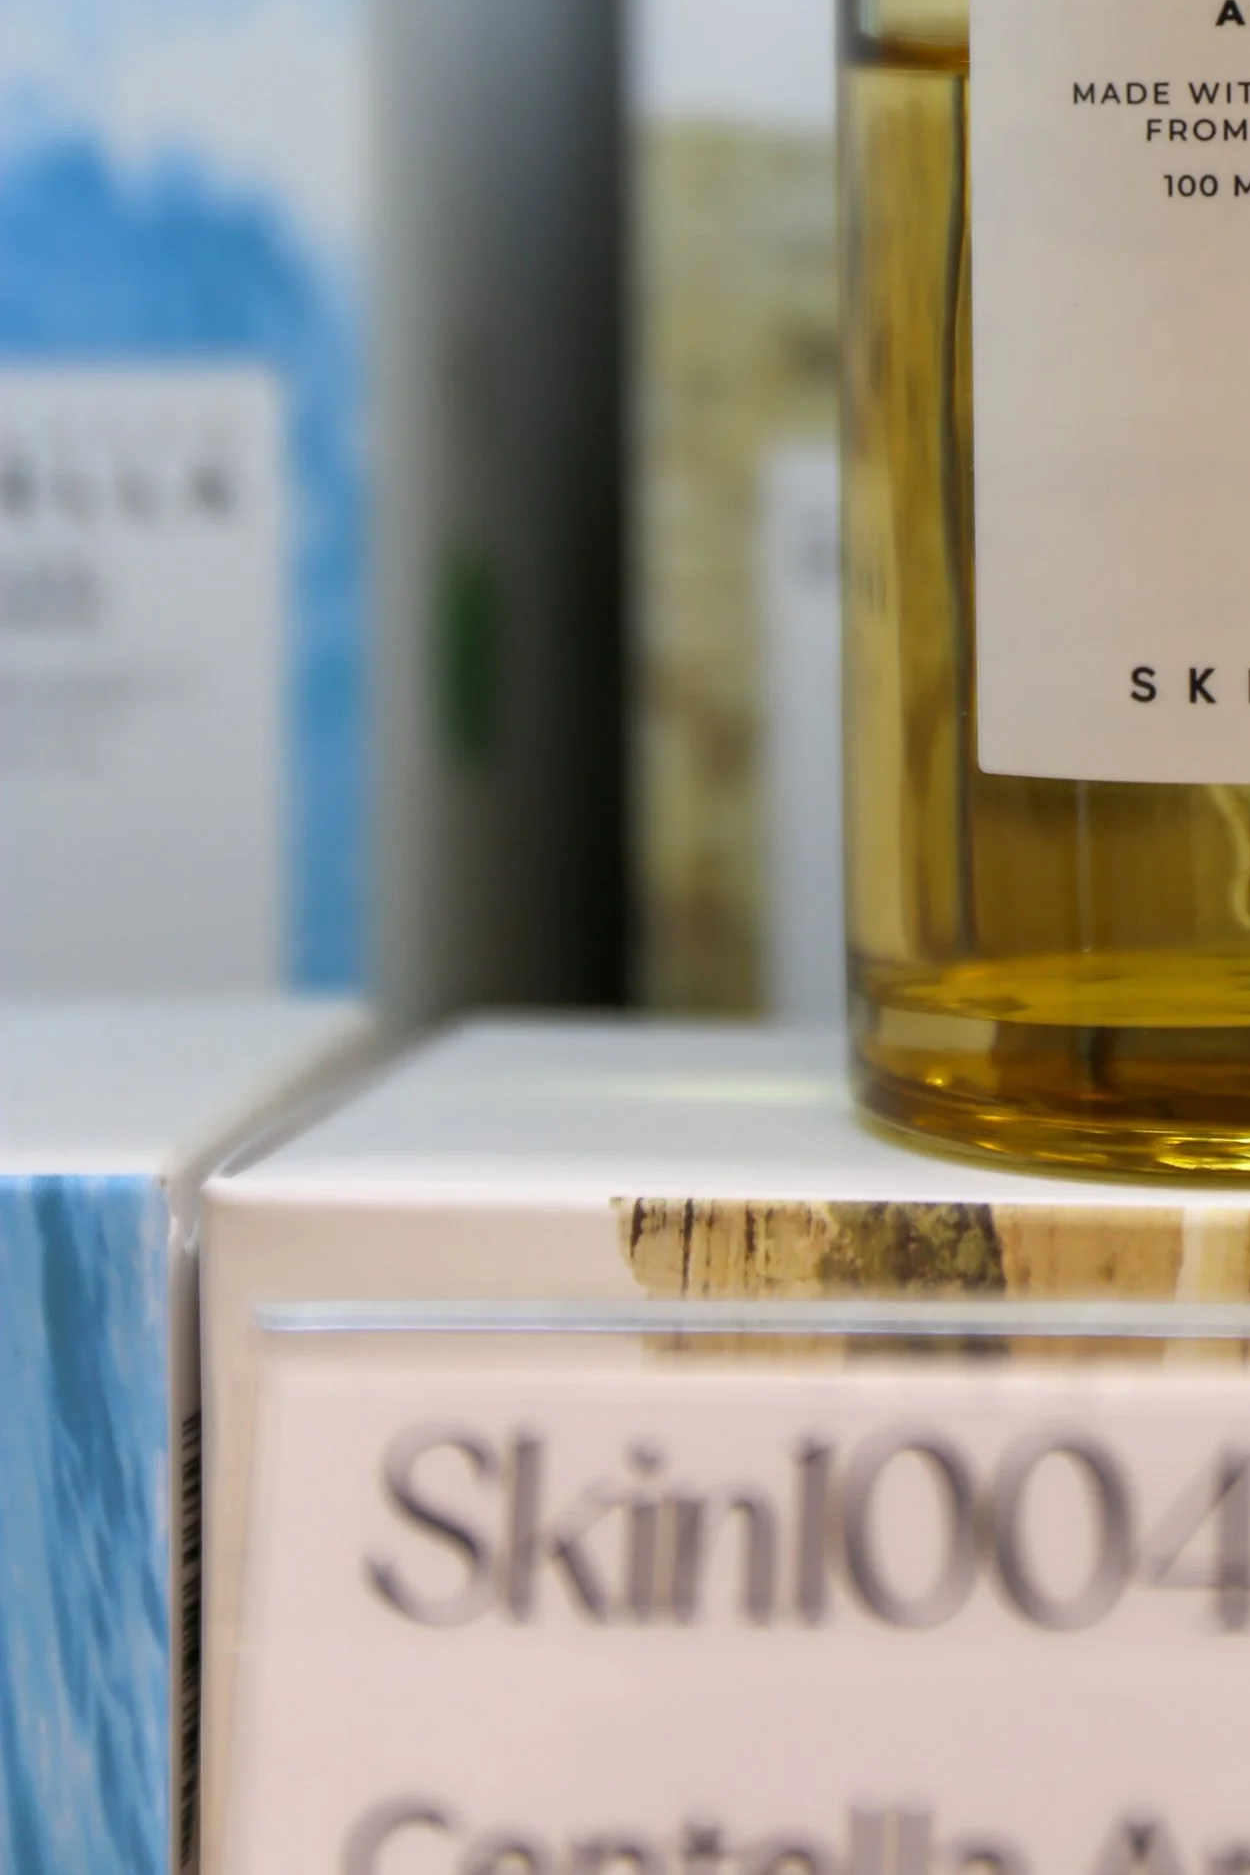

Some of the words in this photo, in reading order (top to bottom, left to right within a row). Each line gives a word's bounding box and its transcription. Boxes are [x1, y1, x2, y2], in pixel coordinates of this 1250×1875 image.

[1071, 81, 1171, 106] MADE
[1145, 117, 1248, 142] FROM
[1163, 173, 1220, 198] 100
